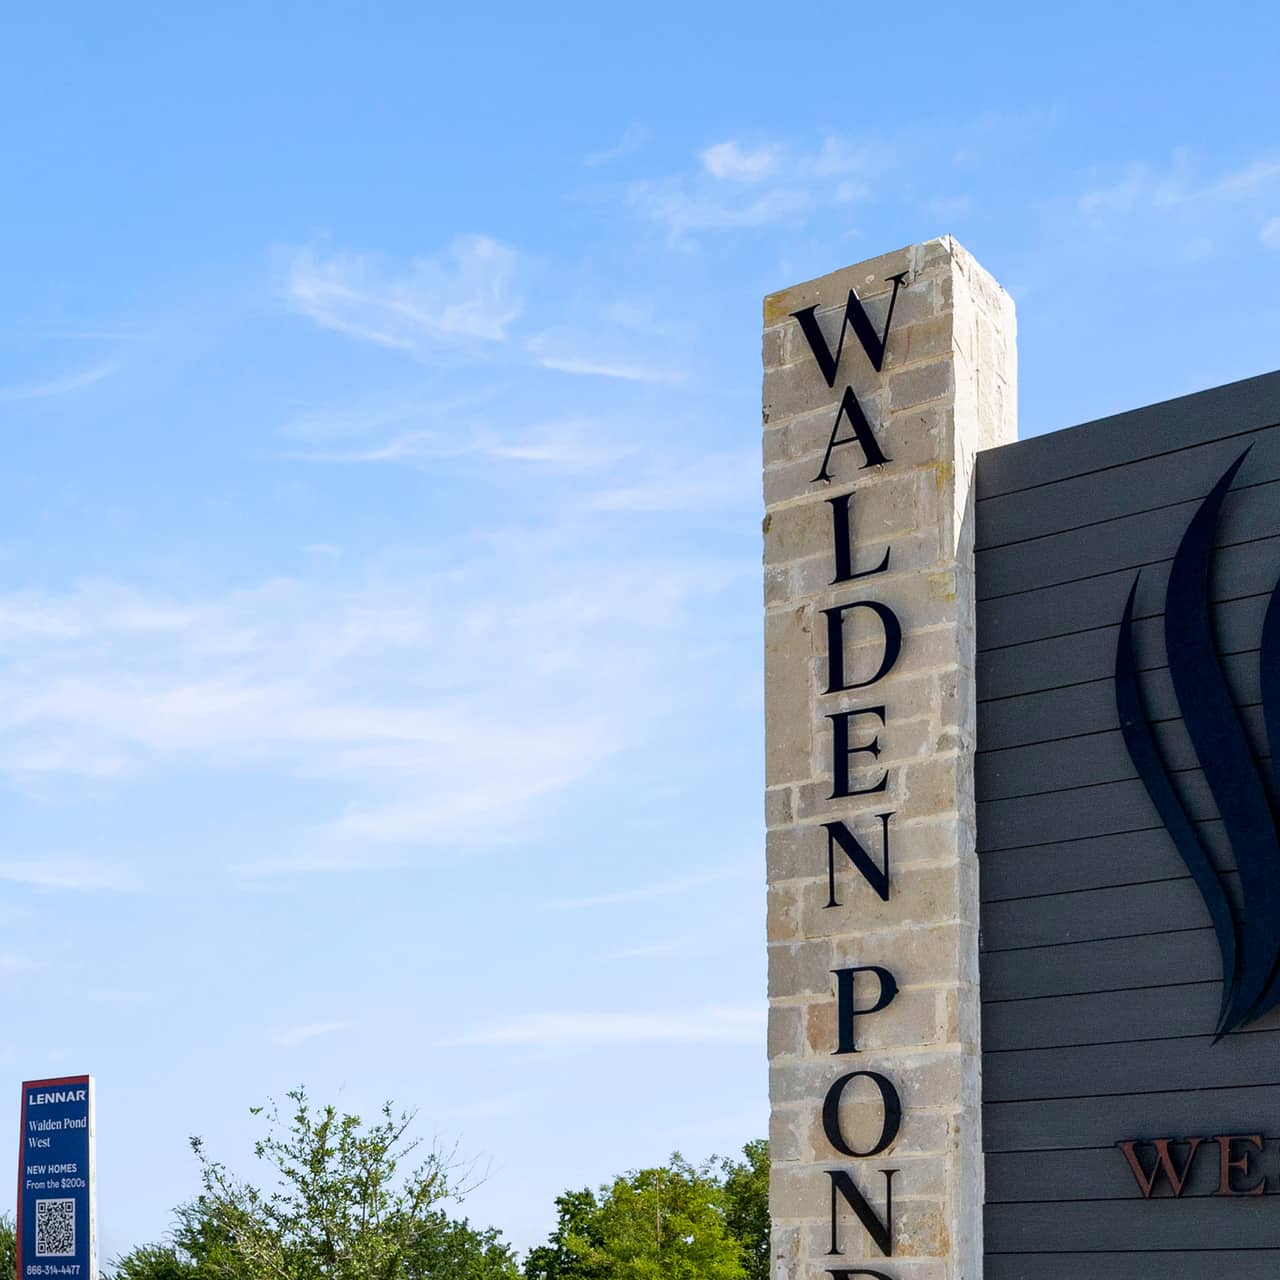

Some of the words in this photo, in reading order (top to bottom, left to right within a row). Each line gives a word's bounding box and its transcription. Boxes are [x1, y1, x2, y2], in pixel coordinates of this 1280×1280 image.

[789, 270, 909, 909] WALDEN
[29, 1090, 86, 1105] LENNAR
[29, 1119, 62, 1132] Walden
[63, 1116, 87, 1129] Pond
[28, 1137, 51, 1148] West
[27, 1165, 46, 1175] NEW
[48, 1163, 77, 1174] HOMES
[26, 1180, 46, 1190] From
[47, 1179, 60, 1189] the
[61, 1178, 86, 1189] $200s
[26, 1265, 81, 1275] 866-314-4477
